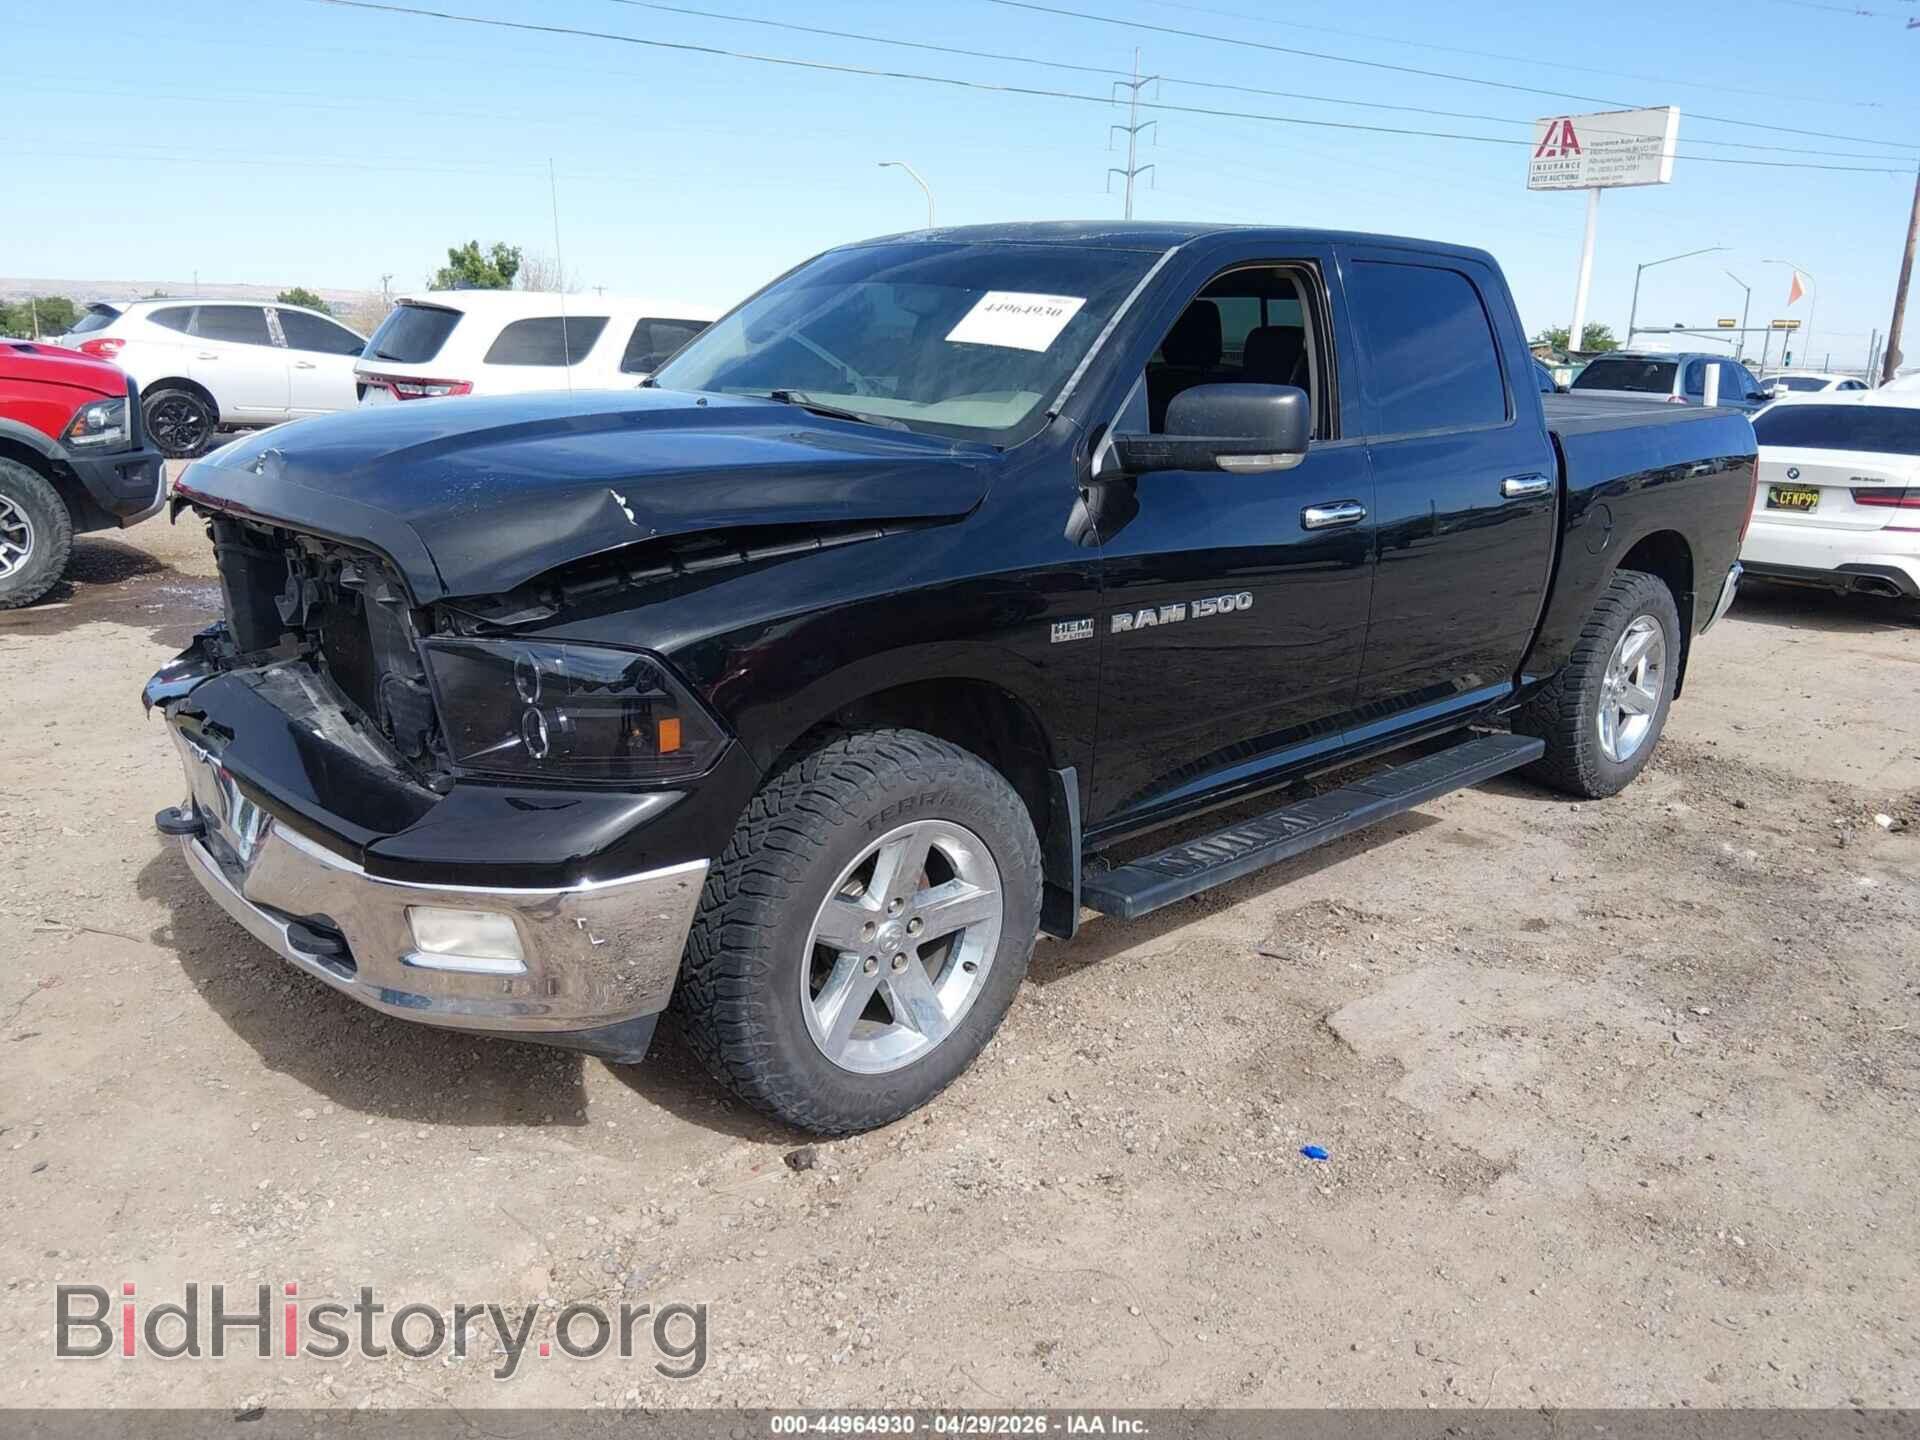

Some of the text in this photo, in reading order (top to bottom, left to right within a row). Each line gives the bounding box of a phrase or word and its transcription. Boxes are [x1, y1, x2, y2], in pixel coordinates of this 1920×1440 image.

[1532, 161, 1580, 172] INSURANCE
[1531, 174, 1547, 182] AUTO
[1549, 173, 1579, 182] AUCTIONS
[1111, 592, 1253, 633] RAM 1500
[1055, 618, 1094, 634] HEMI
